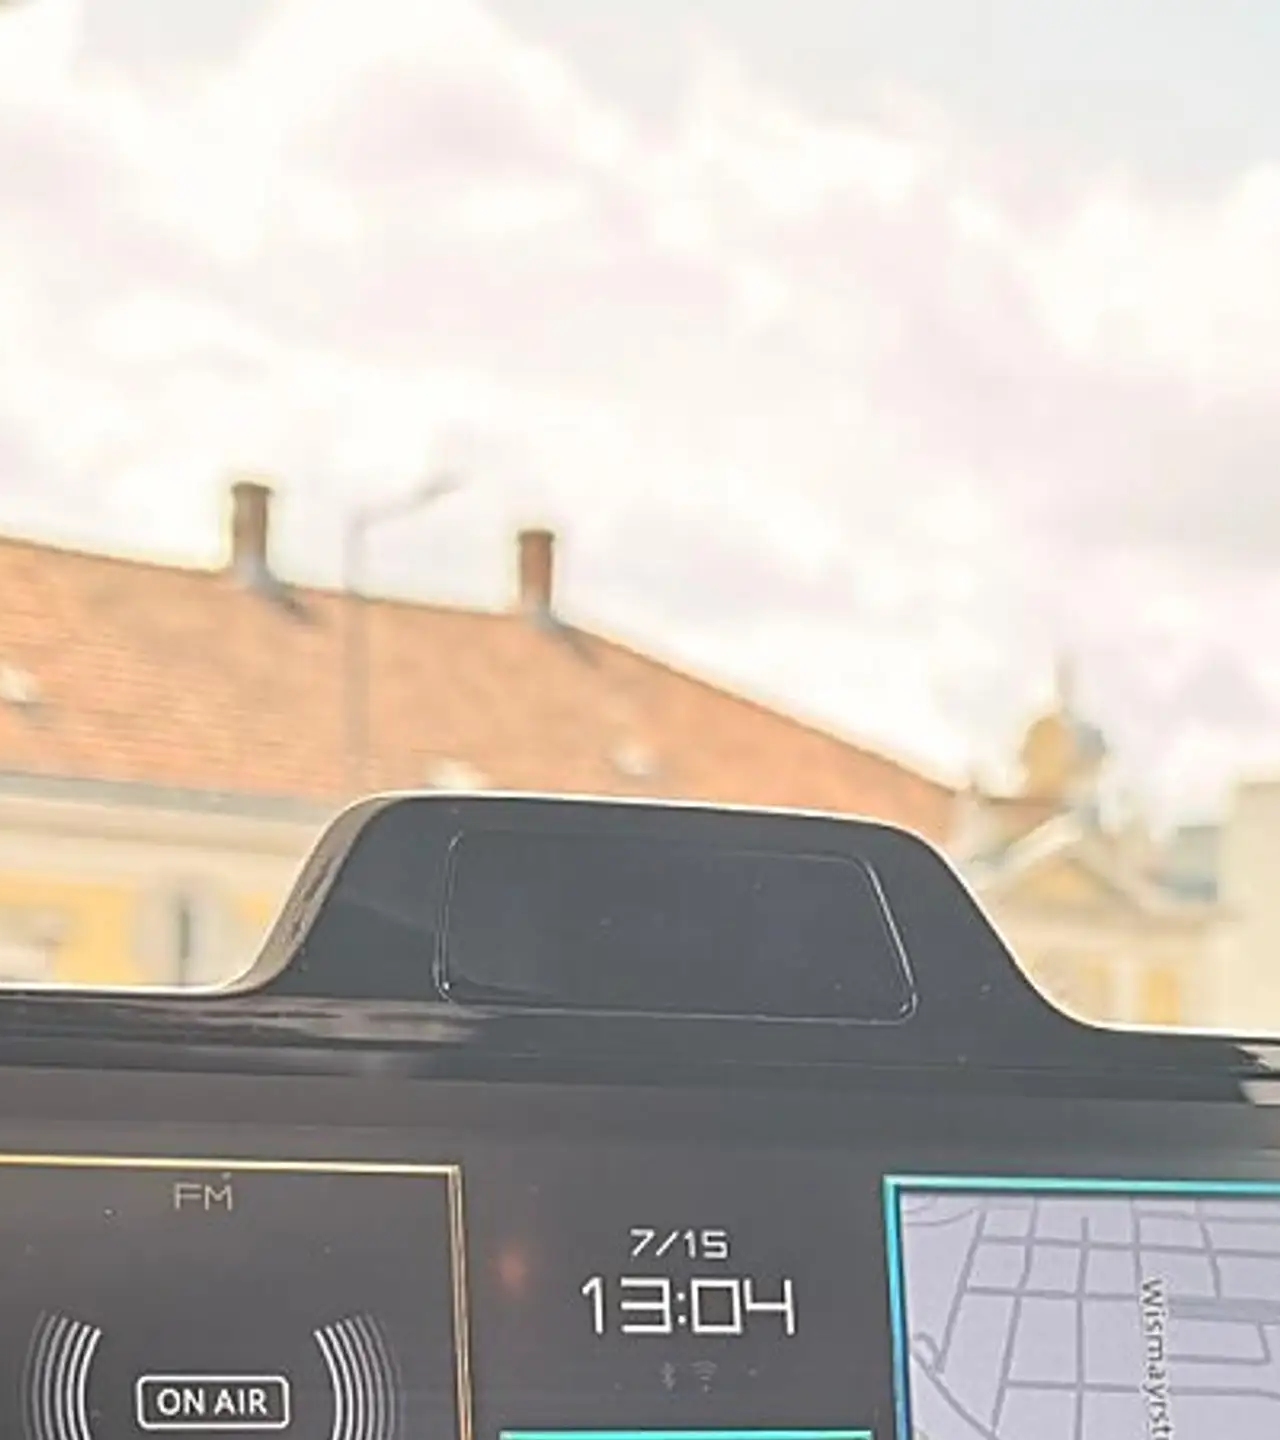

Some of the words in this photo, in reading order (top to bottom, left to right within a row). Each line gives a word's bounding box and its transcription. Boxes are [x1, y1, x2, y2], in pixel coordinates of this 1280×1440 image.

[175, 1183, 233, 1211] FM
[629, 1229, 729, 1259] 7/15
[582, 1276, 796, 1335] 13:04
[157, 1389, 206, 1416] ON
[215, 1388, 268, 1415] AIR
